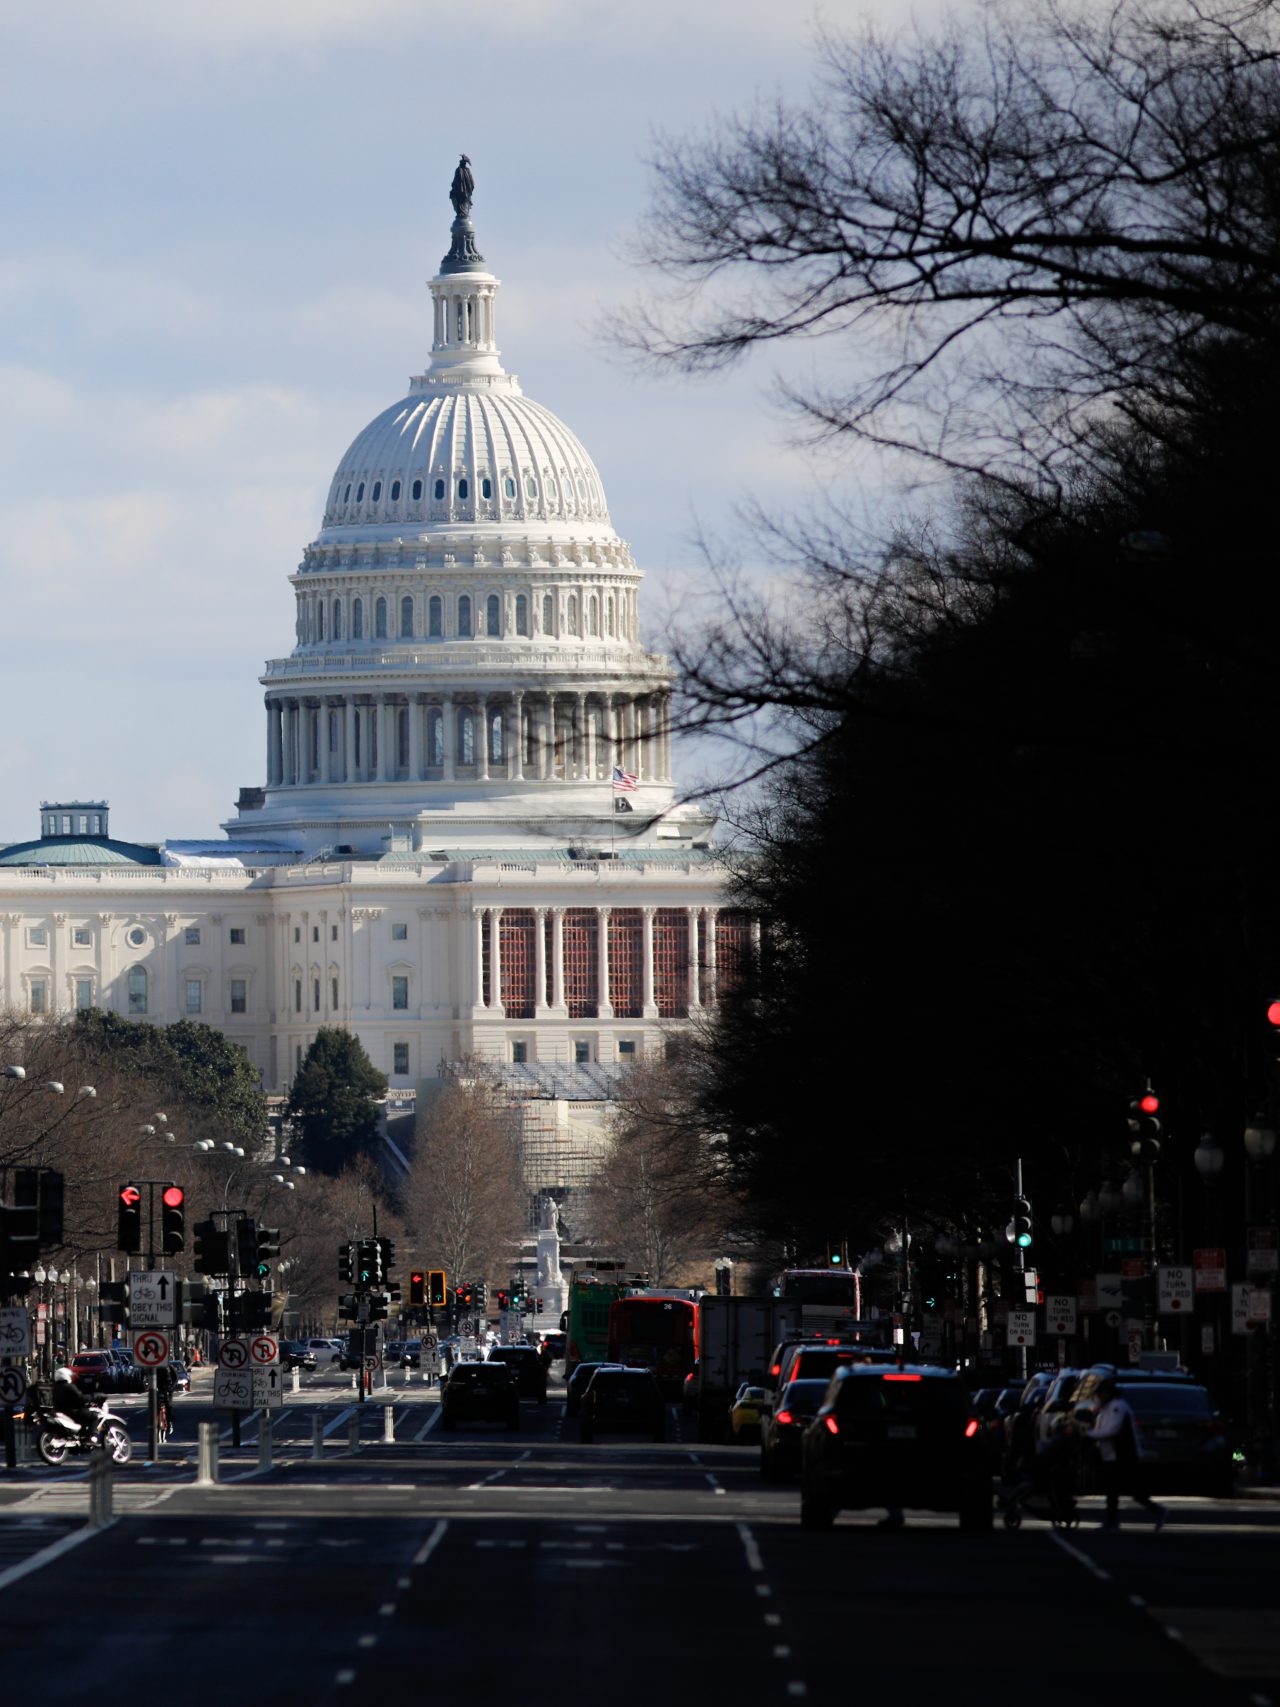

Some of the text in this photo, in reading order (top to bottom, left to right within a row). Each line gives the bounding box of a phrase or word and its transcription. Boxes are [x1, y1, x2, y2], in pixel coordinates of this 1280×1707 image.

[1168, 1270, 1182, 1278] NO
[132, 1274, 152, 1283] THRU
[1161, 1290, 1190, 1298] ON RED
[1054, 1298, 1068, 1306] NO
[132, 1303, 172, 1312] OBEY THIS
[133, 1313, 159, 1323] SIGNAL
[1015, 1313, 1027, 1321] NO
[267, 1390, 280, 1398] THIS
